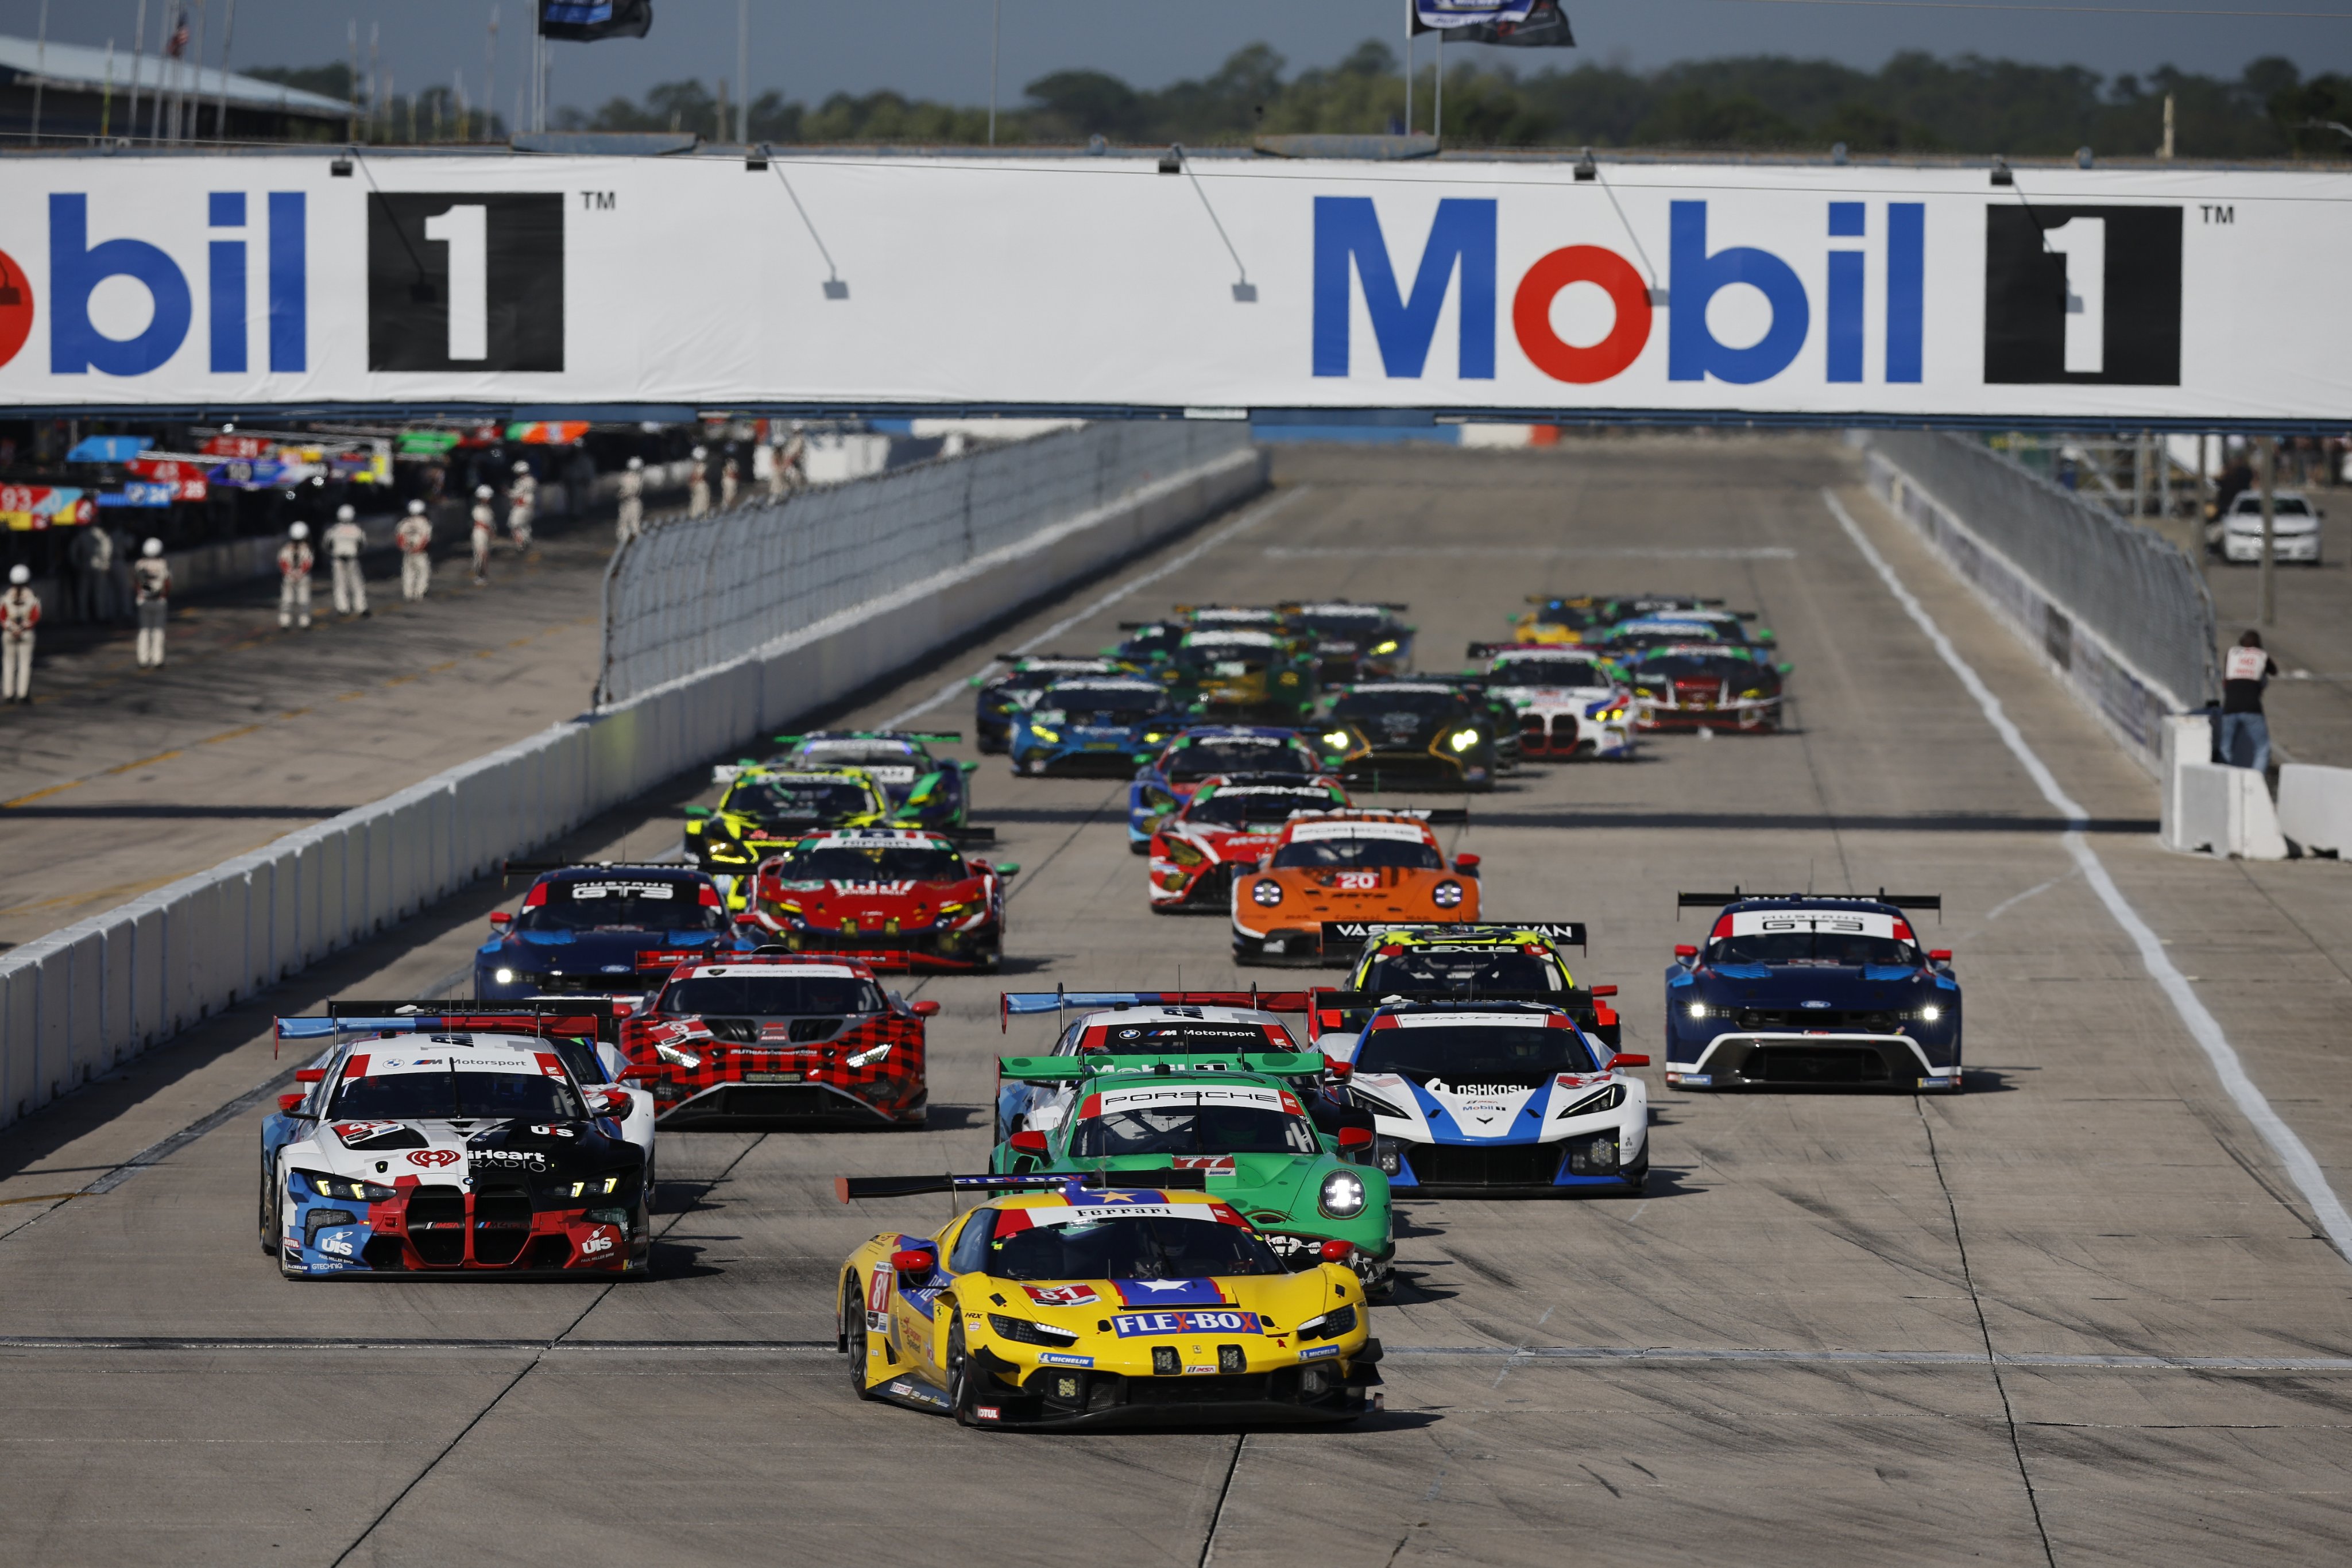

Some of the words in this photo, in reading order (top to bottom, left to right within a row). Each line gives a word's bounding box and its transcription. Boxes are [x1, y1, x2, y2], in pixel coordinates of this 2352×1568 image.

[582, 192, 616, 210] TM
[2200, 204, 2235, 224] TM
[425, 204, 487, 361] 1
[1313, 196, 1925, 385] Mobil
[2043, 217, 2105, 373] 1
[1, 486, 32, 512] 93
[1341, 875, 1375, 889] 20
[572, 886, 674, 900] GT3
[1762, 920, 1863, 931] GT3
[1412, 946, 1518, 954] LEXUS
[1183, 1029, 1256, 1037] Motorsport
[1457, 1084, 1528, 1095] OSHKOSH
[1105, 1091, 1278, 1105] PORSCHE
[531, 1125, 574, 1137] UIS
[467, 1149, 545, 1163] iHeart
[1180, 1157, 1227, 1168] 77
[468, 1159, 546, 1172] RADIO
[1076, 1206, 1173, 1217] Ferrari
[284, 1239, 299, 1248] MOTUL
[322, 1238, 354, 1256] UIS
[582, 1236, 613, 1254] UIS
[872, 1273, 889, 1311] 81
[1036, 1287, 1079, 1300] 81
[1116, 1312, 1256, 1334] FLEX-BOX
[1309, 1348, 1337, 1357] MICHELIN
[1050, 1356, 1090, 1365] MICHELIN
